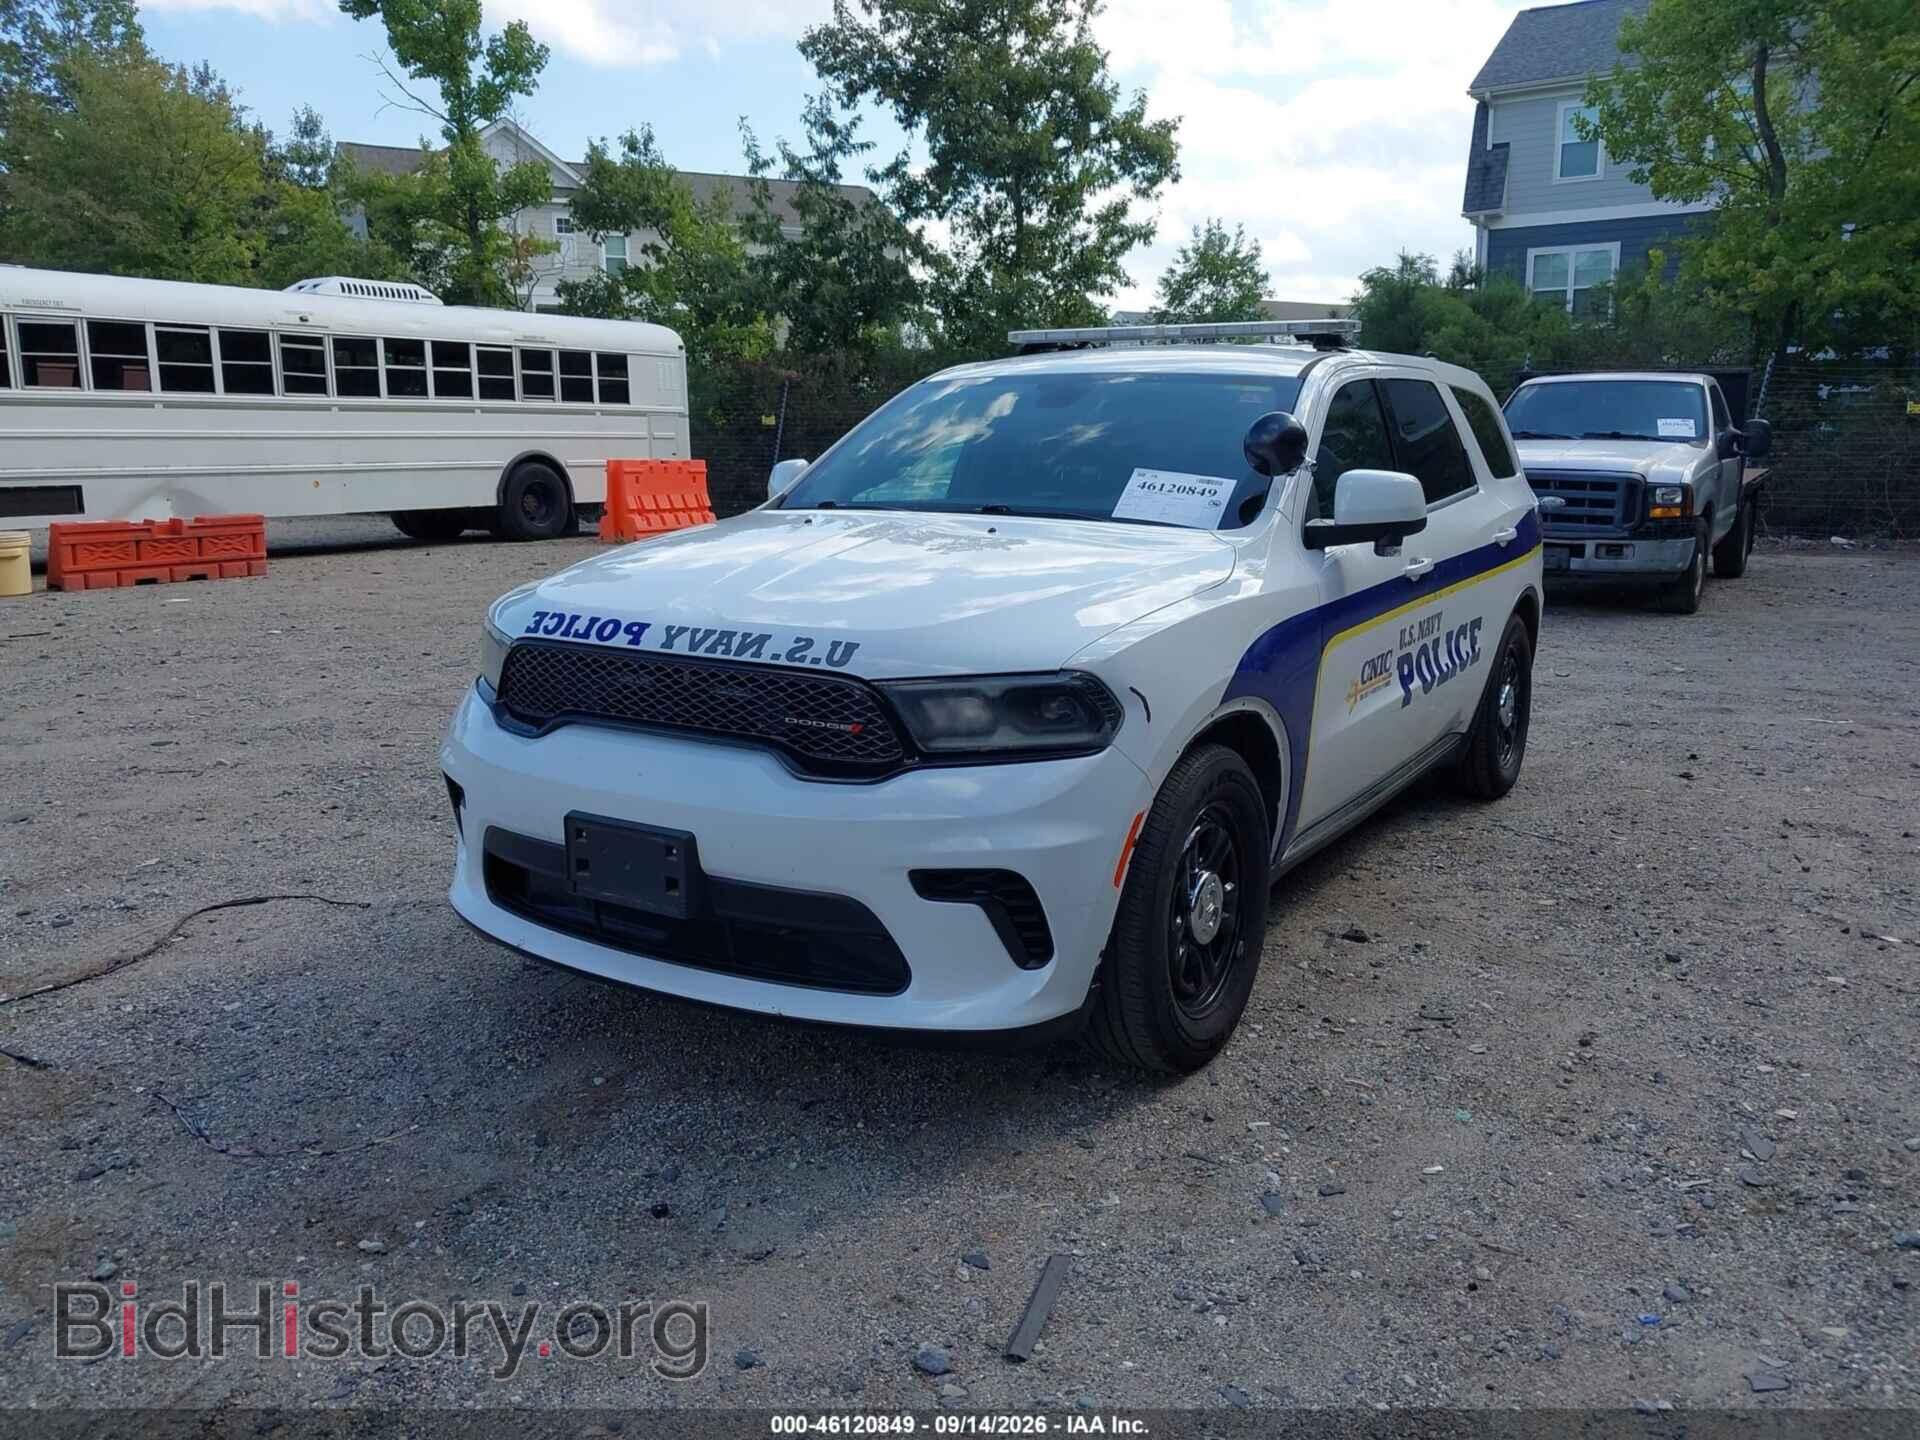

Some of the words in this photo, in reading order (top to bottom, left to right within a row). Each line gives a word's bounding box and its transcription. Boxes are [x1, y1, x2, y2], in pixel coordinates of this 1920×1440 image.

[1137, 481, 1218, 497] 46120849
[1361, 649, 1393, 684] CNIC
[1397, 616, 1483, 709] POLICE
[785, 718, 848, 730] DODGE
